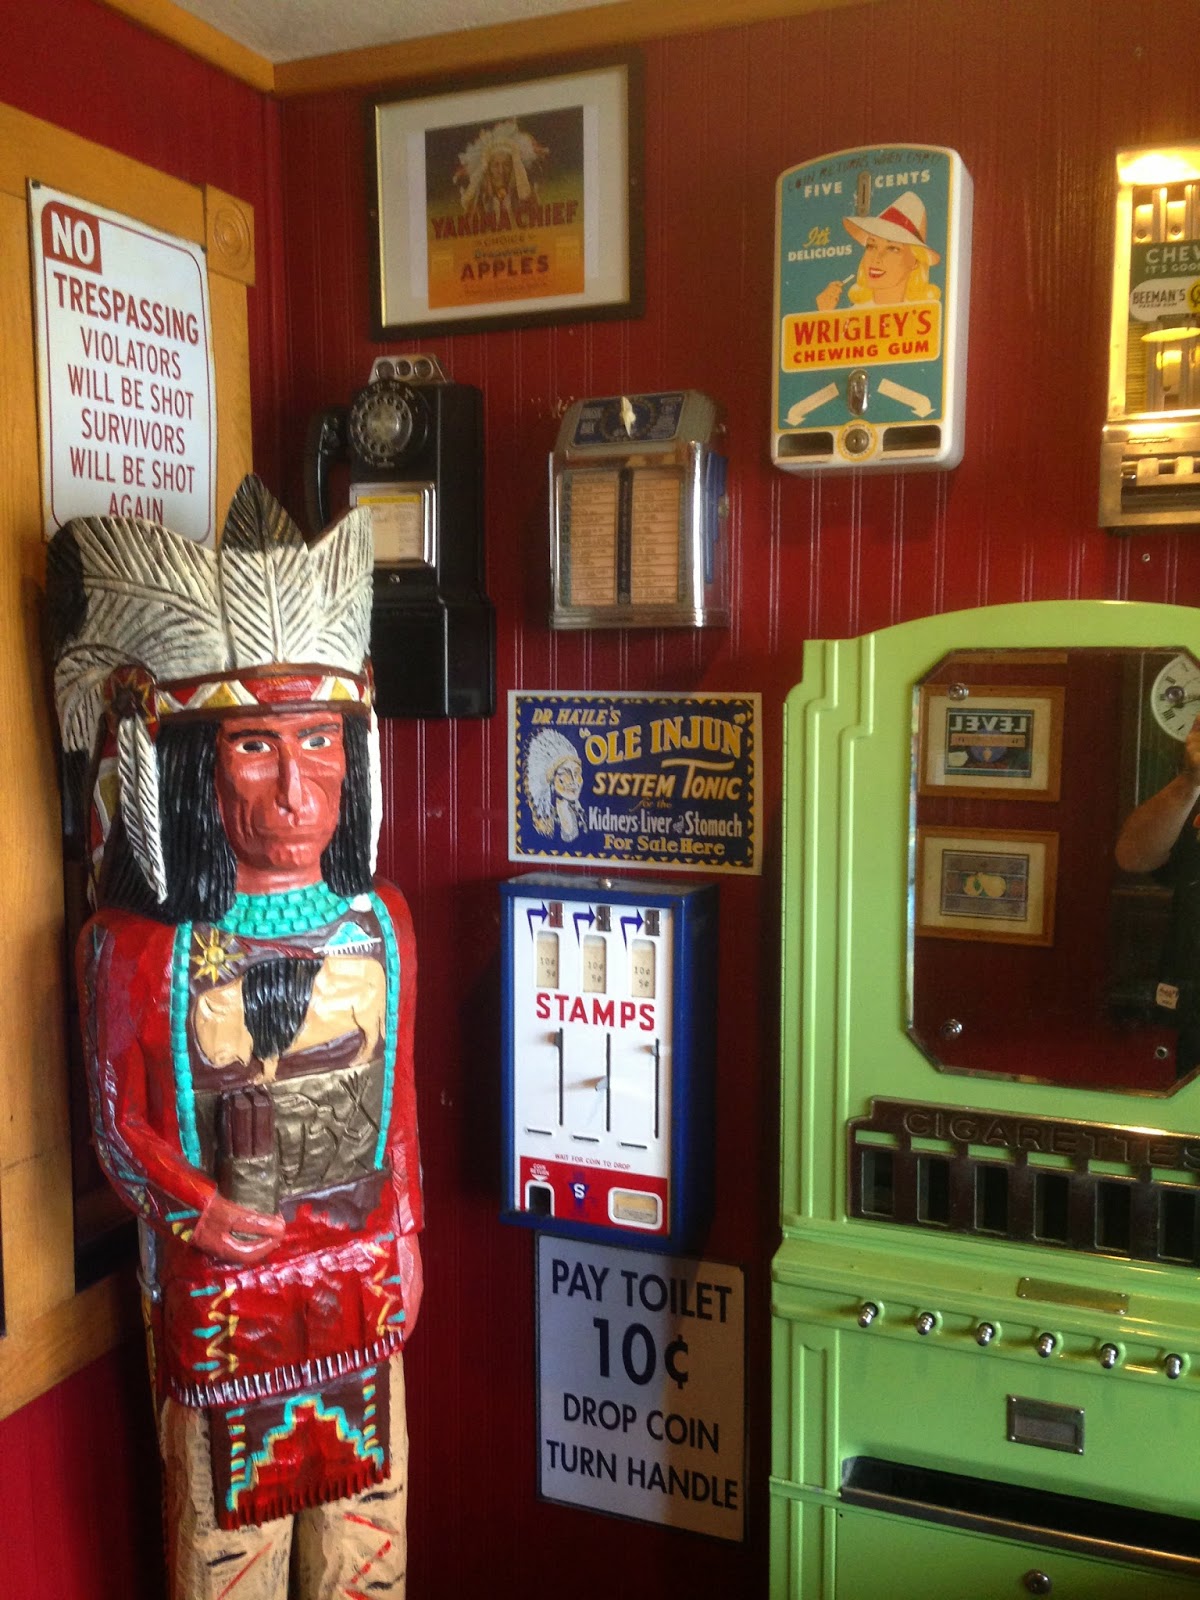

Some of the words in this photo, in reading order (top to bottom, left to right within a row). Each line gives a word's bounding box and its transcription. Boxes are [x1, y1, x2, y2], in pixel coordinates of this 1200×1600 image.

[804, 181, 843, 198] FIVE
[874, 169, 931, 188] CENTS
[51, 210, 96, 266] NO
[431, 208, 511, 240] YAKIMA
[515, 200, 578, 229] CHIEF
[461, 255, 549, 282] APPLES
[788, 245, 853, 262] DELICIOUS
[53, 271, 200, 346] TRESPASSING
[1132, 288, 1186, 305] BEEMAN'S
[793, 310, 932, 347] WRIGLEY'S
[80, 325, 182, 381] VIOLATORS
[793, 345, 879, 364] CHEWING
[888, 340, 929, 356] GUM
[68, 363, 114, 405] WILL
[121, 376, 144, 411] BE
[150, 384, 194, 422] SHOT
[81, 407, 186, 457] SURVIVORS
[70, 446, 116, 484] WILL
[123, 455, 146, 489] BE
[151, 461, 195, 494] SHOT
[109, 492, 164, 525] AGAIN
[592, 771, 676, 798] SYSTEM
[661, 758, 743, 800] TONIC
[640, 808, 673, 834] Liver
[685, 810, 743, 838] Stomach
[656, 799, 673, 809] the
[603, 833, 634, 851] For
[637, 835, 679, 852] Sale
[680, 837, 726, 856] Here
[536, 992, 655, 1031] STAMPS
[904, 1108, 1200, 1171] CIGARETTES
[555, 1153, 570, 1161] WAIT
[571, 1155, 584, 1163] FOR
[585, 1157, 601, 1166] COIN
[613, 1161, 631, 1170] DROP
[574, 1182, 586, 1199] S
[552, 1258, 610, 1302] PAY
[620, 1269, 732, 1323] TOILET
[563, 1392, 637, 1433] DROP
[646, 1410, 719, 1454] COIN
[546, 1438, 617, 1483] TURN
[627, 1456, 738, 1510] HANDLE
